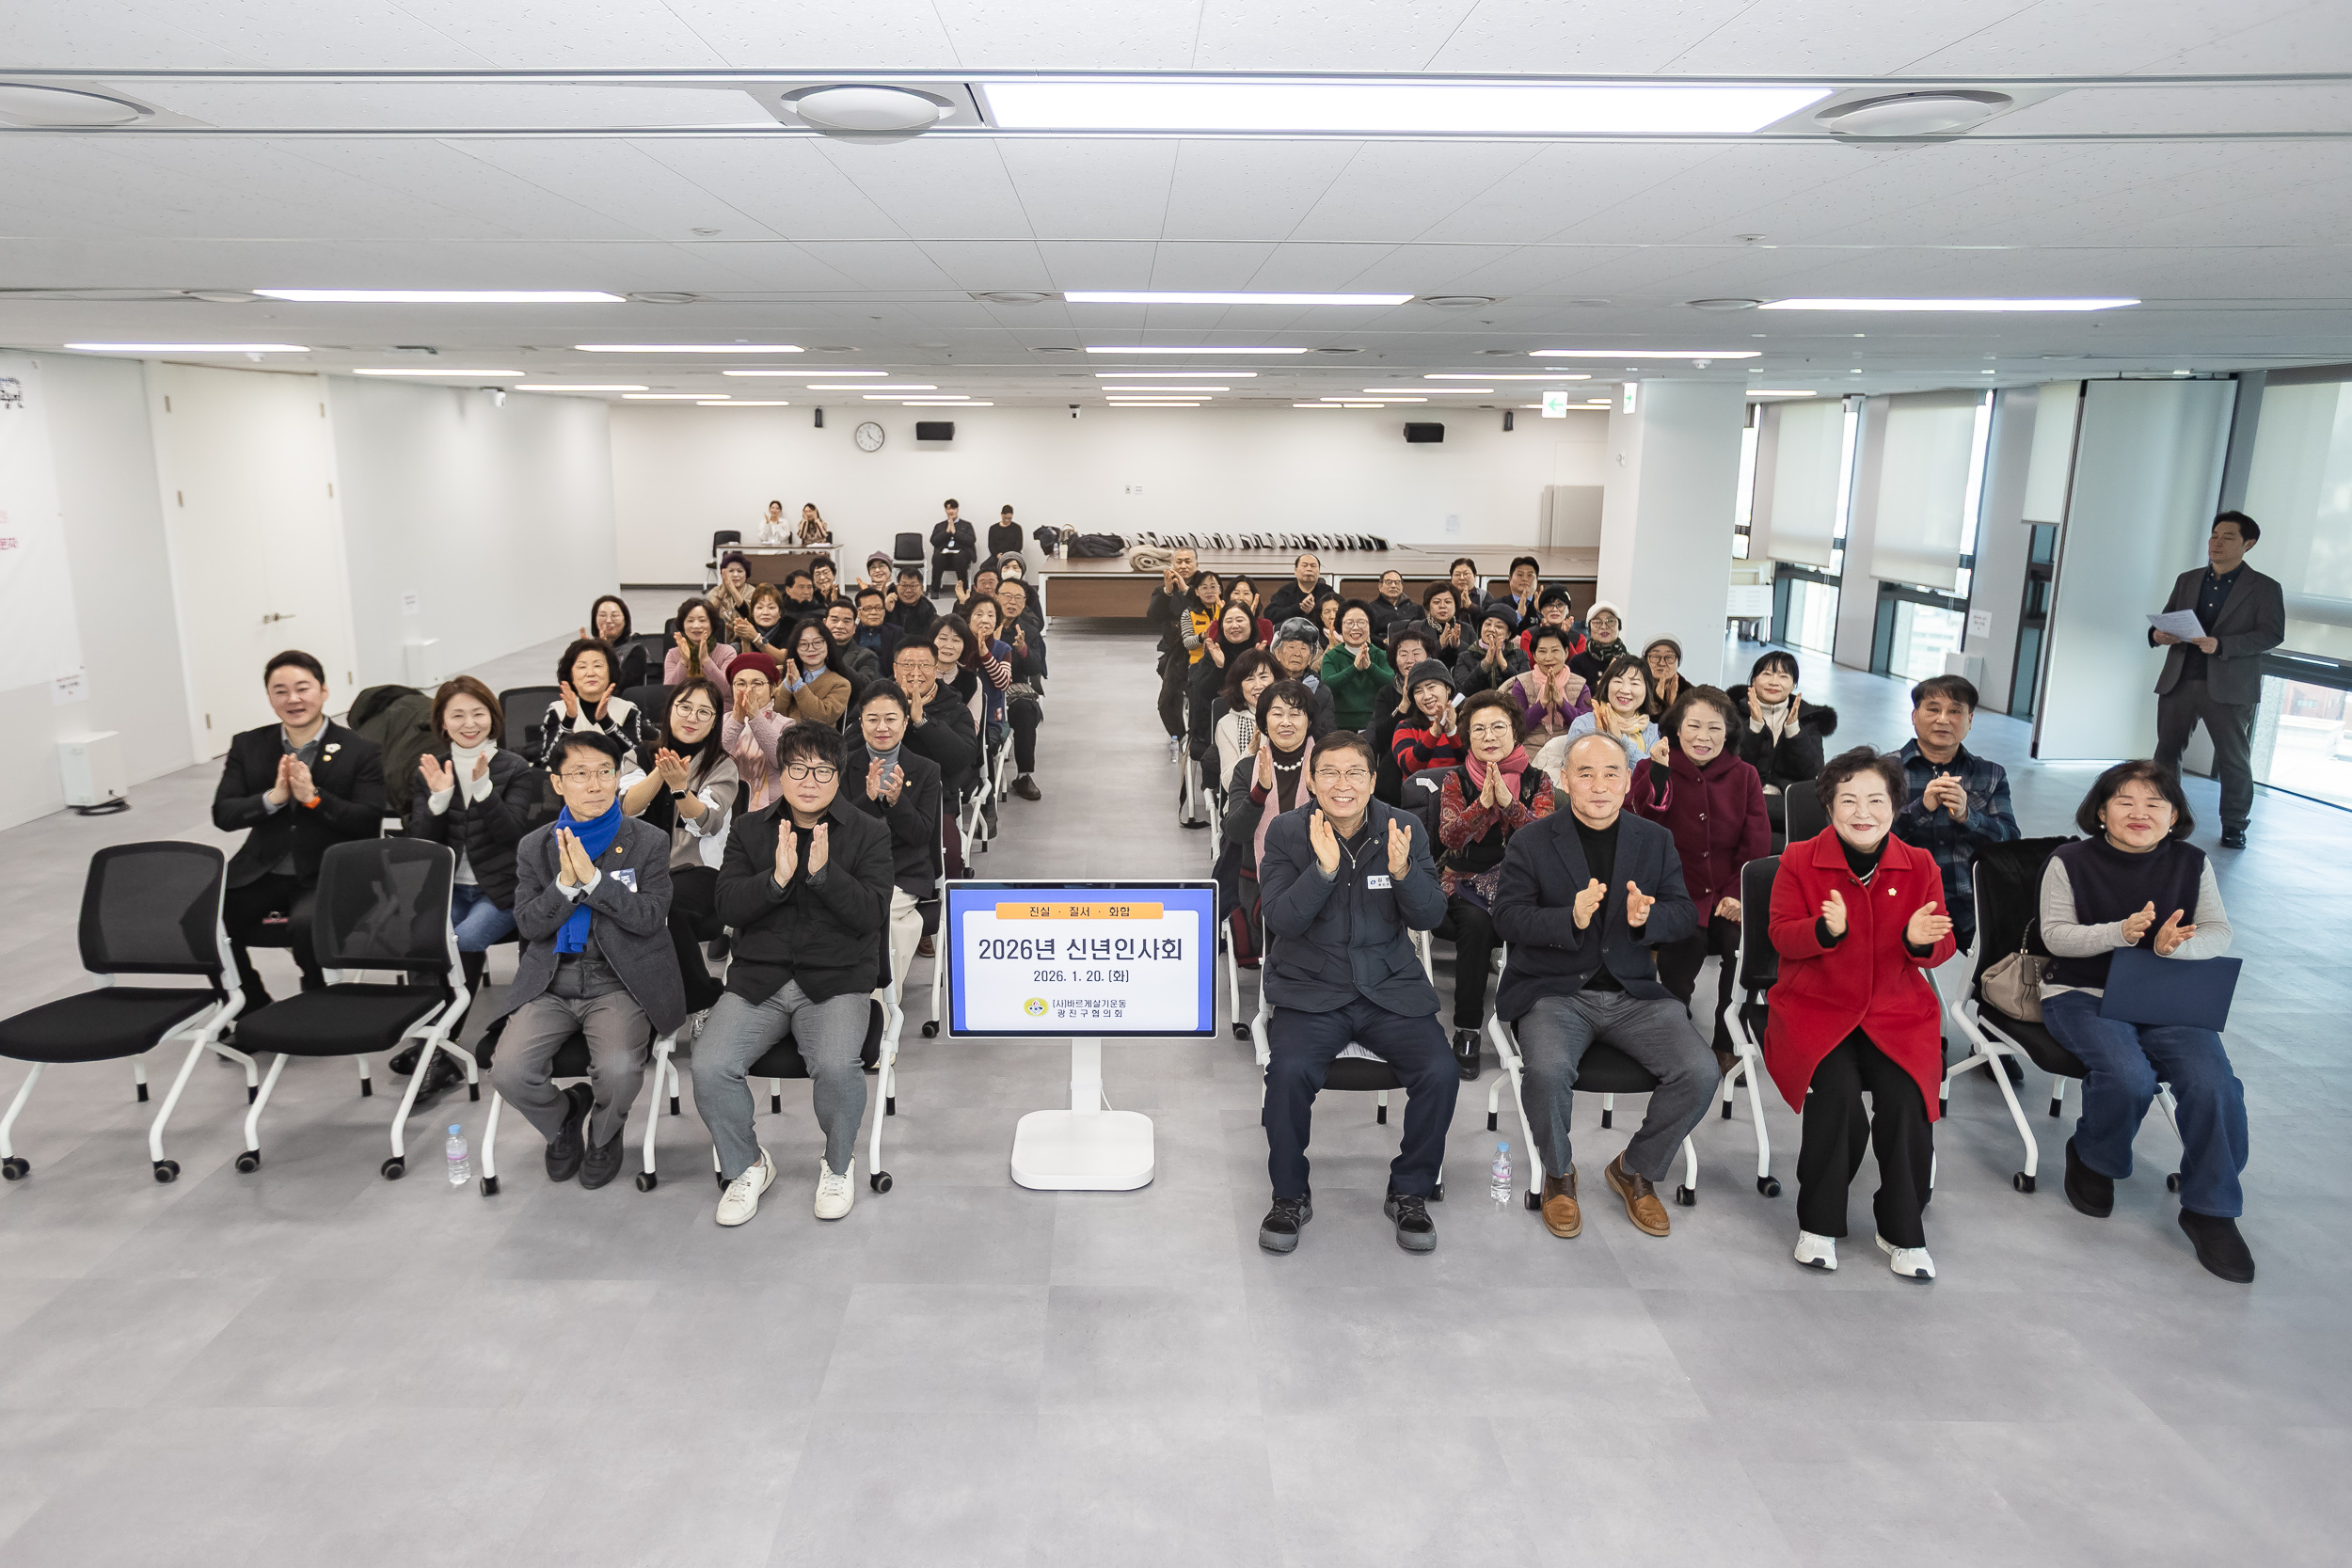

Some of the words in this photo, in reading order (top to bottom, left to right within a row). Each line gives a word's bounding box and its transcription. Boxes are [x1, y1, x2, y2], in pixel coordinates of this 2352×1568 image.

[1029, 906, 1050, 917] 진실
[1069, 906, 1089, 917] 질서
[1108, 906, 1130, 917] 화합
[978, 939, 1056, 960] 2026년
[1066, 938, 1183, 961] 신년인사회
[1033, 970, 1067, 983] 2026.
[1072, 970, 1082, 983] 1.
[1086, 970, 1104, 983] 20.
